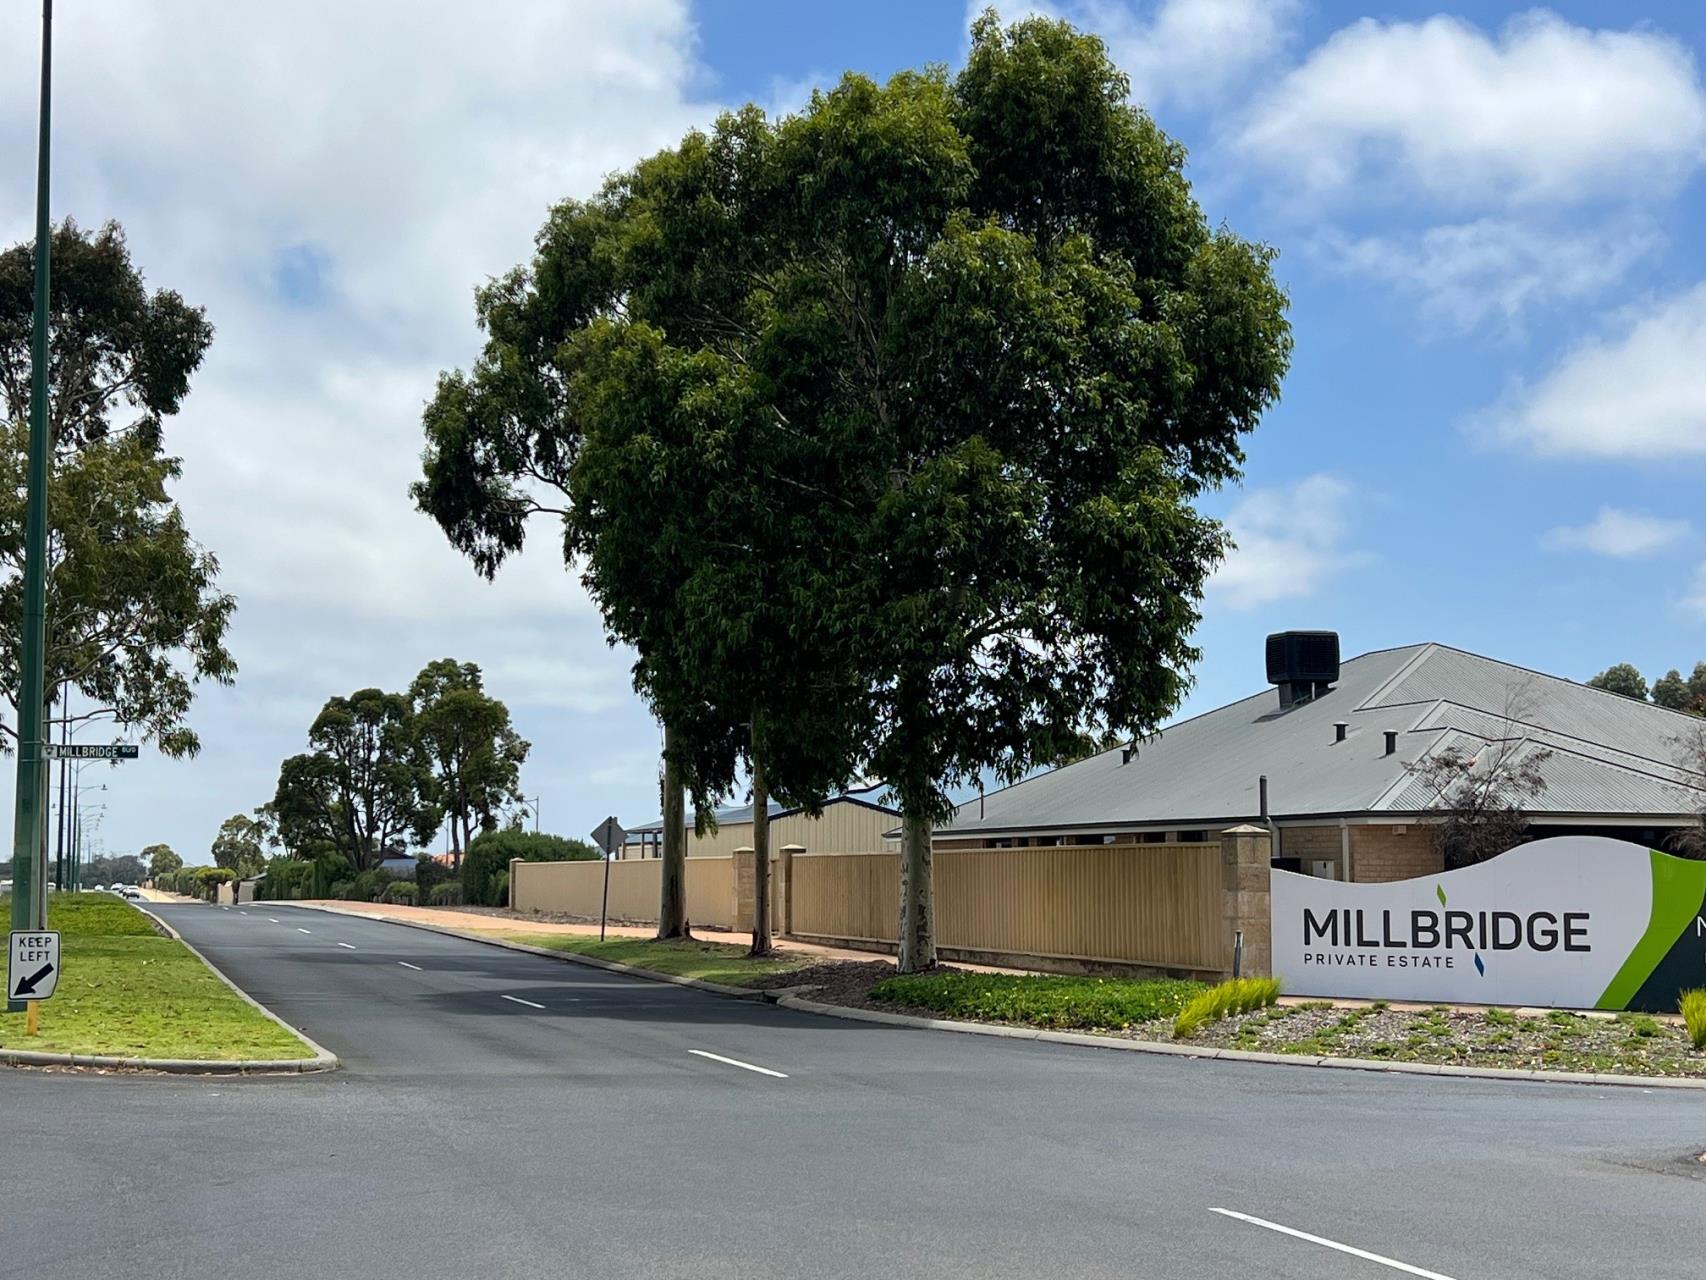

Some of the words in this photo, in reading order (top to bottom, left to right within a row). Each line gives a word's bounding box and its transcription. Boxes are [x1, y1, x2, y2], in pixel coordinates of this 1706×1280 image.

[59, 747, 118, 757] MILLBRIDGE
[1303, 908, 1591, 952] MILLBRIDGE
[19, 937, 52, 947] KEEP
[20, 951, 50, 962] LEFT
[1304, 953, 1378, 967] PRIVATE
[1387, 955, 1454, 969] ESTATE
